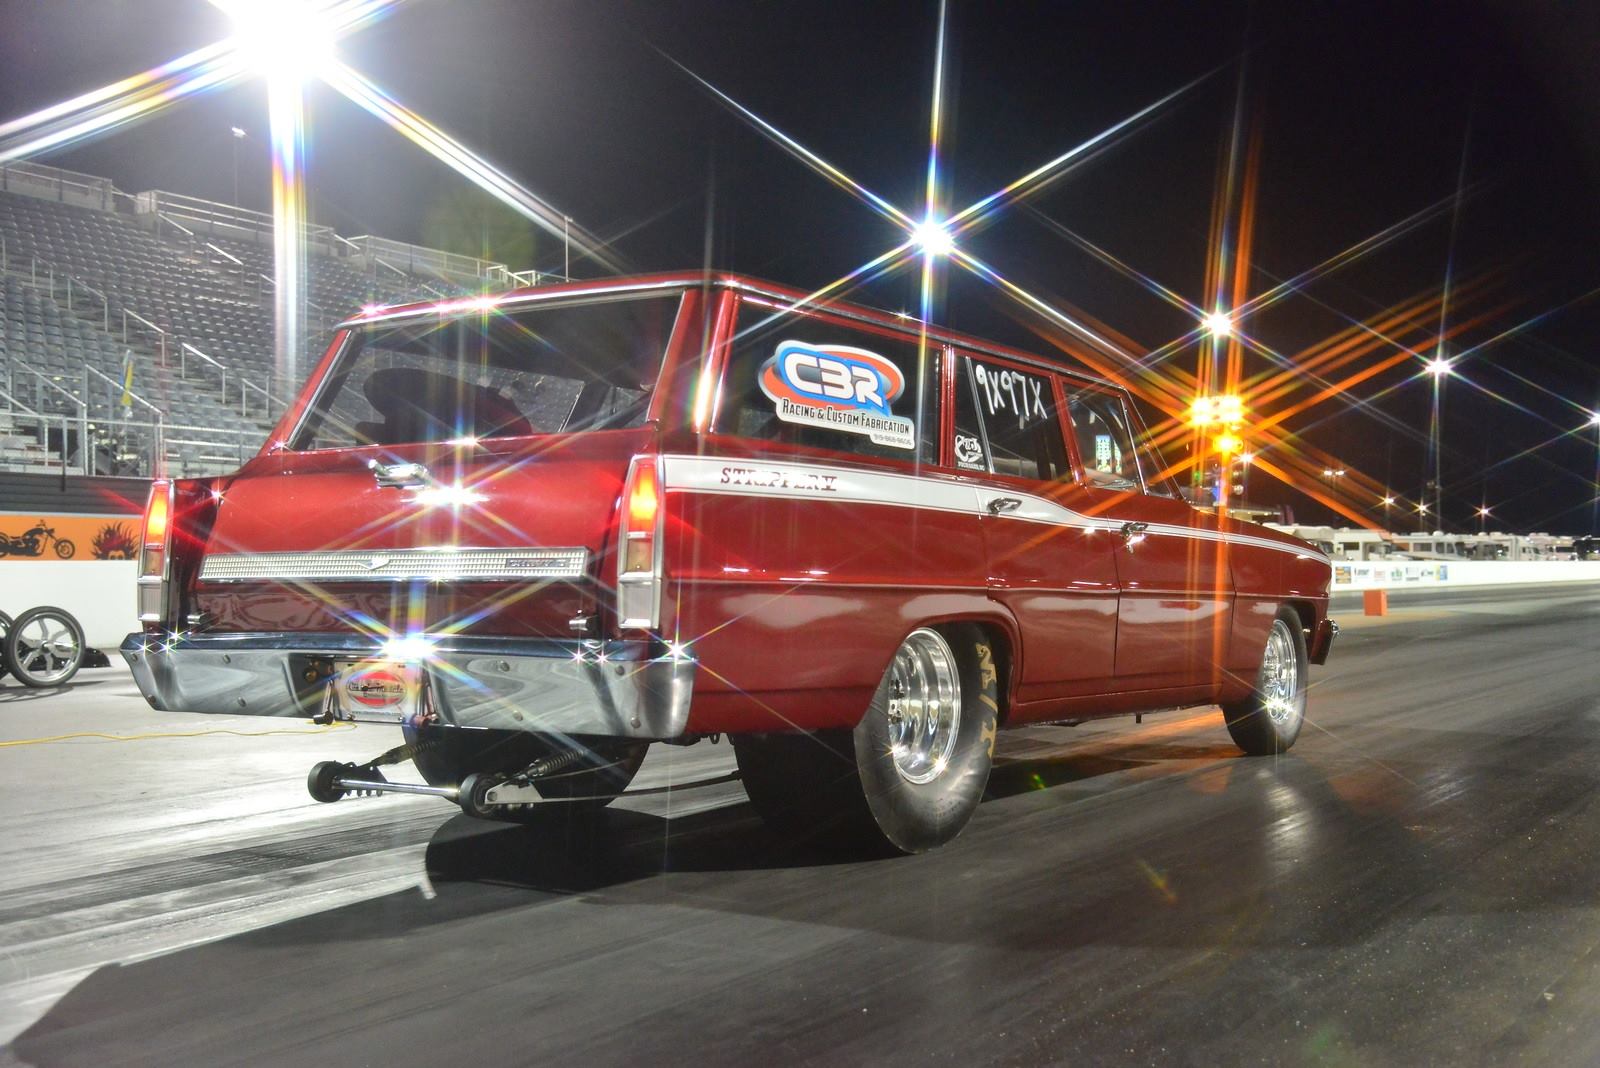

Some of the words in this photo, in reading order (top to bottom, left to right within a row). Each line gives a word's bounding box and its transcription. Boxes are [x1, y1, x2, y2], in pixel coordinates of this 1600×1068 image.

[784, 353, 884, 407] CBR
[976, 365, 1048, 419] 9X97X
[782, 398, 815, 418] RACING
[817, 408, 825, 420] &
[826, 407, 860, 426] CUSTOM
[861, 412, 910, 435] FABRICATION
